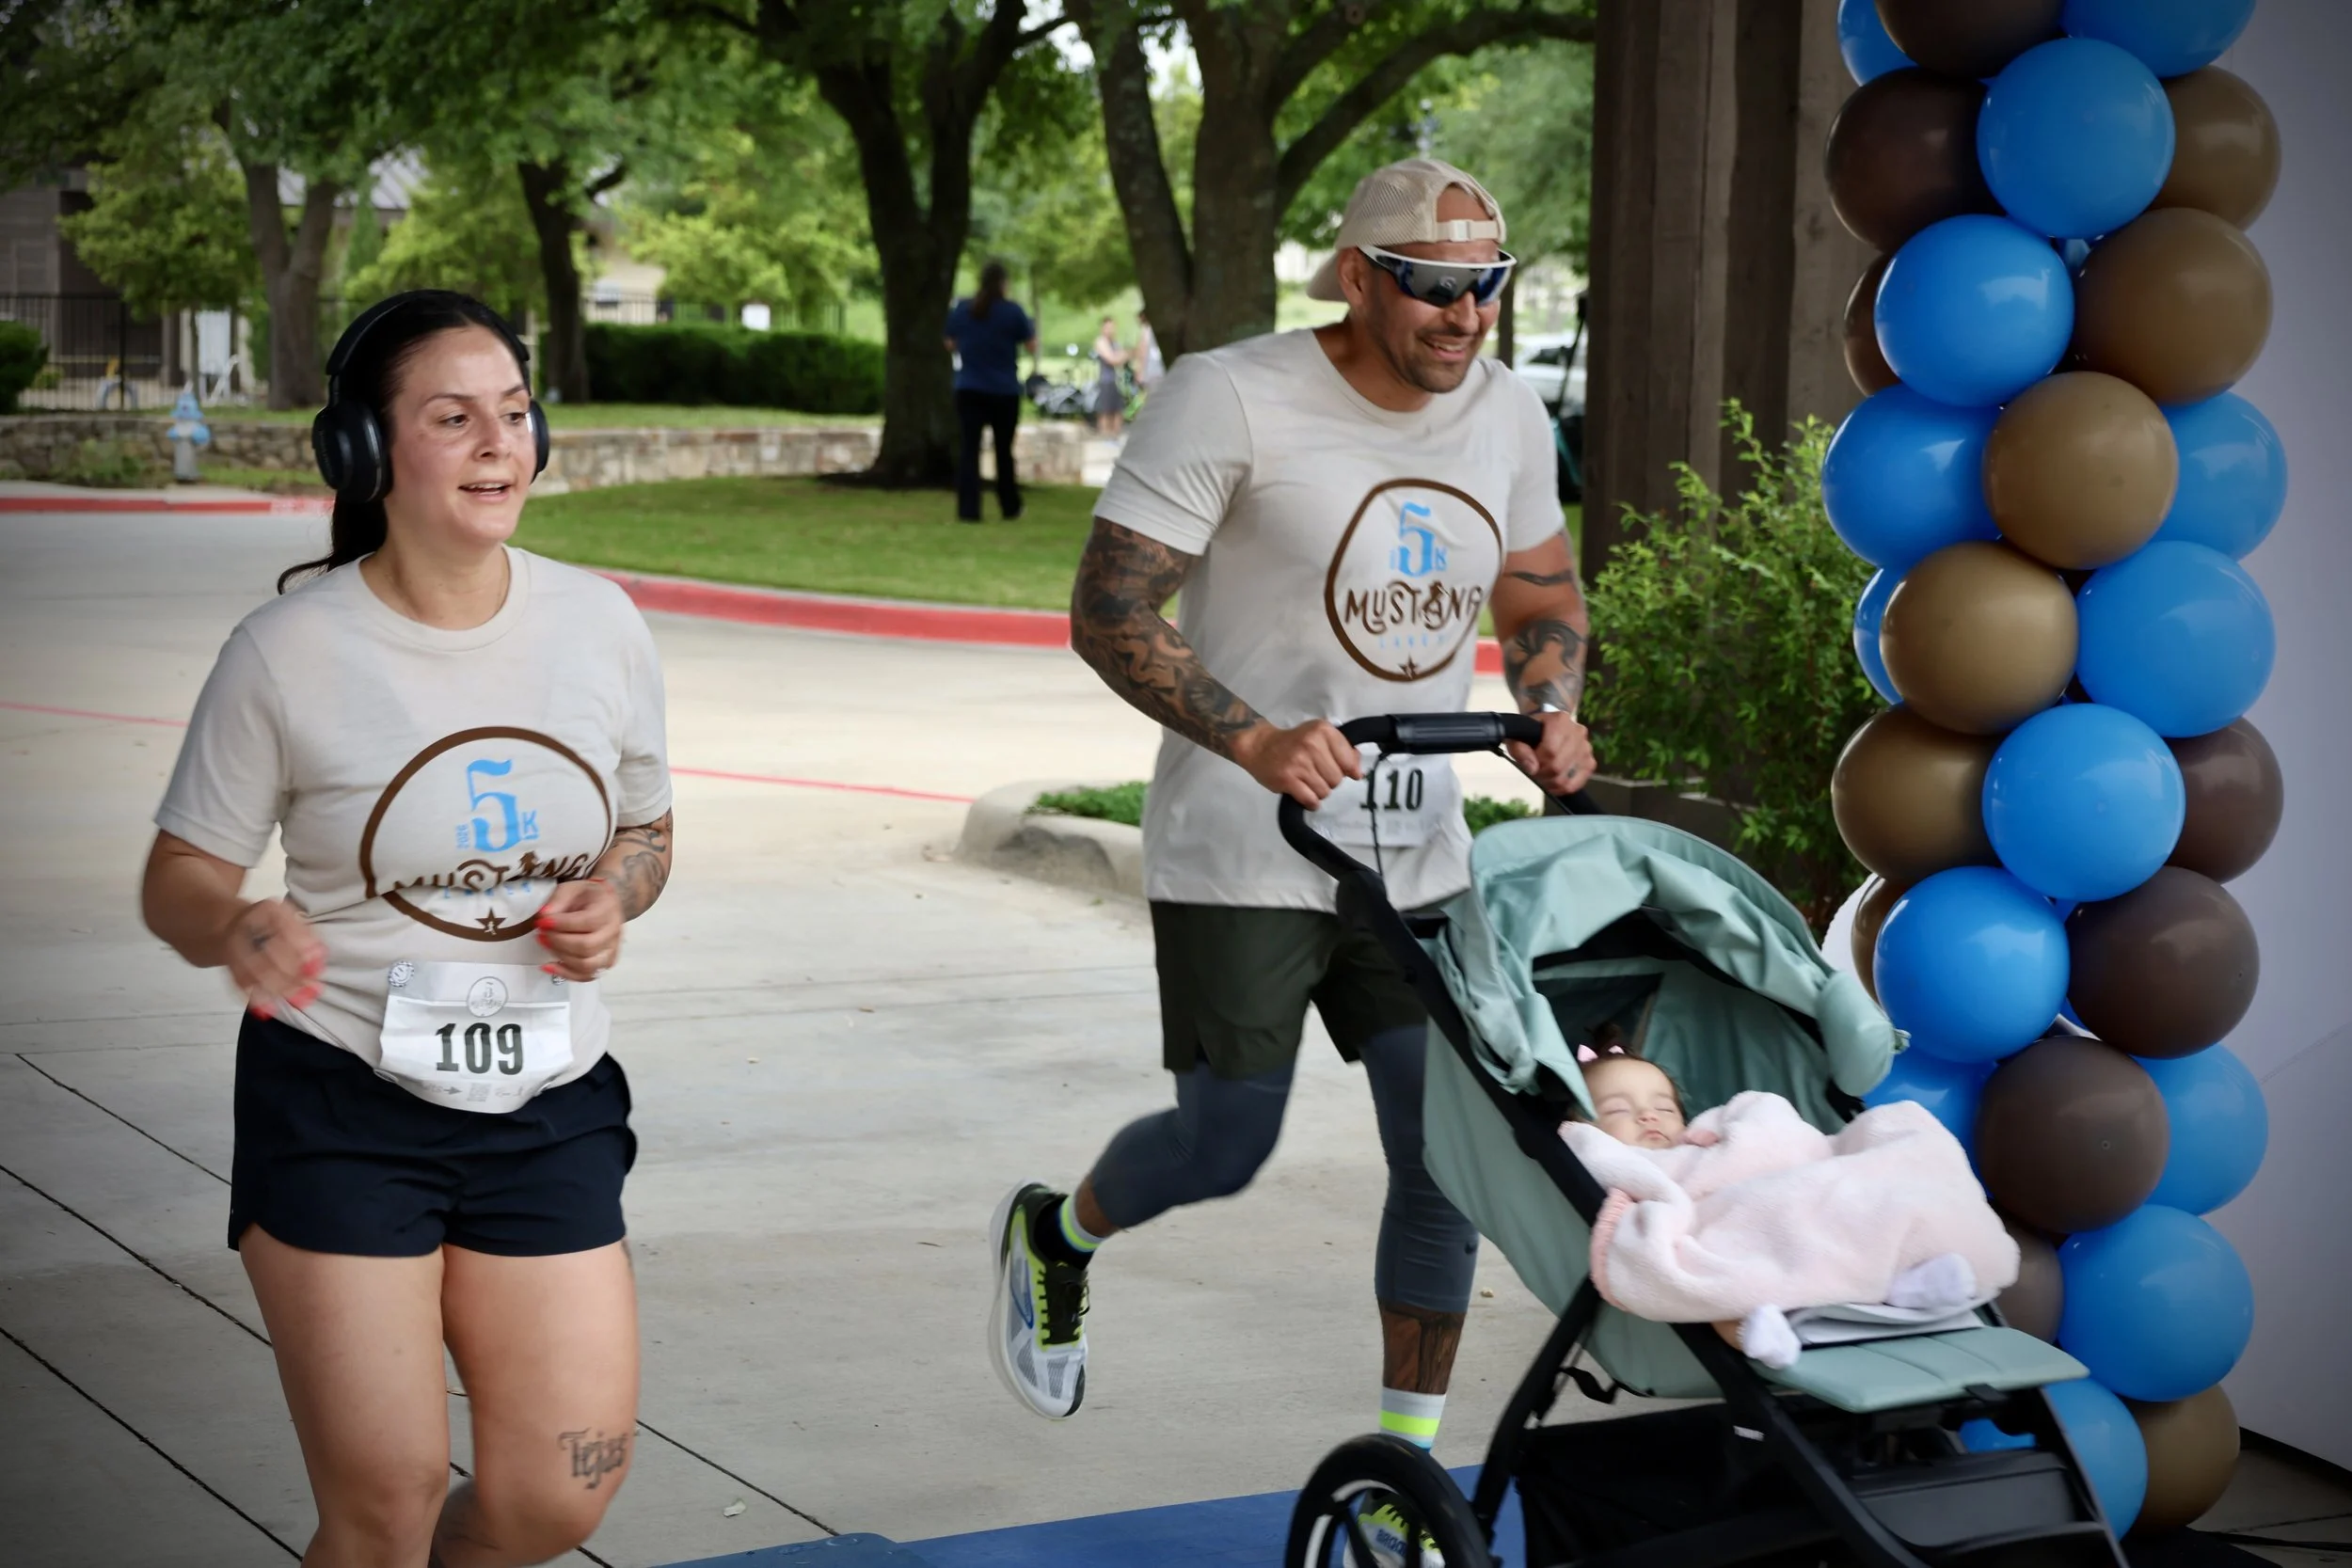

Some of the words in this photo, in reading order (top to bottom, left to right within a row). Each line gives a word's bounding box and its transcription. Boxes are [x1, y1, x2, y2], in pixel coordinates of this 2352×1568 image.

[1360, 768, 1423, 812] 110
[392, 850, 589, 893] STNG
[435, 1022, 523, 1075] 109
[1375, 1528, 1410, 1559] BROO
